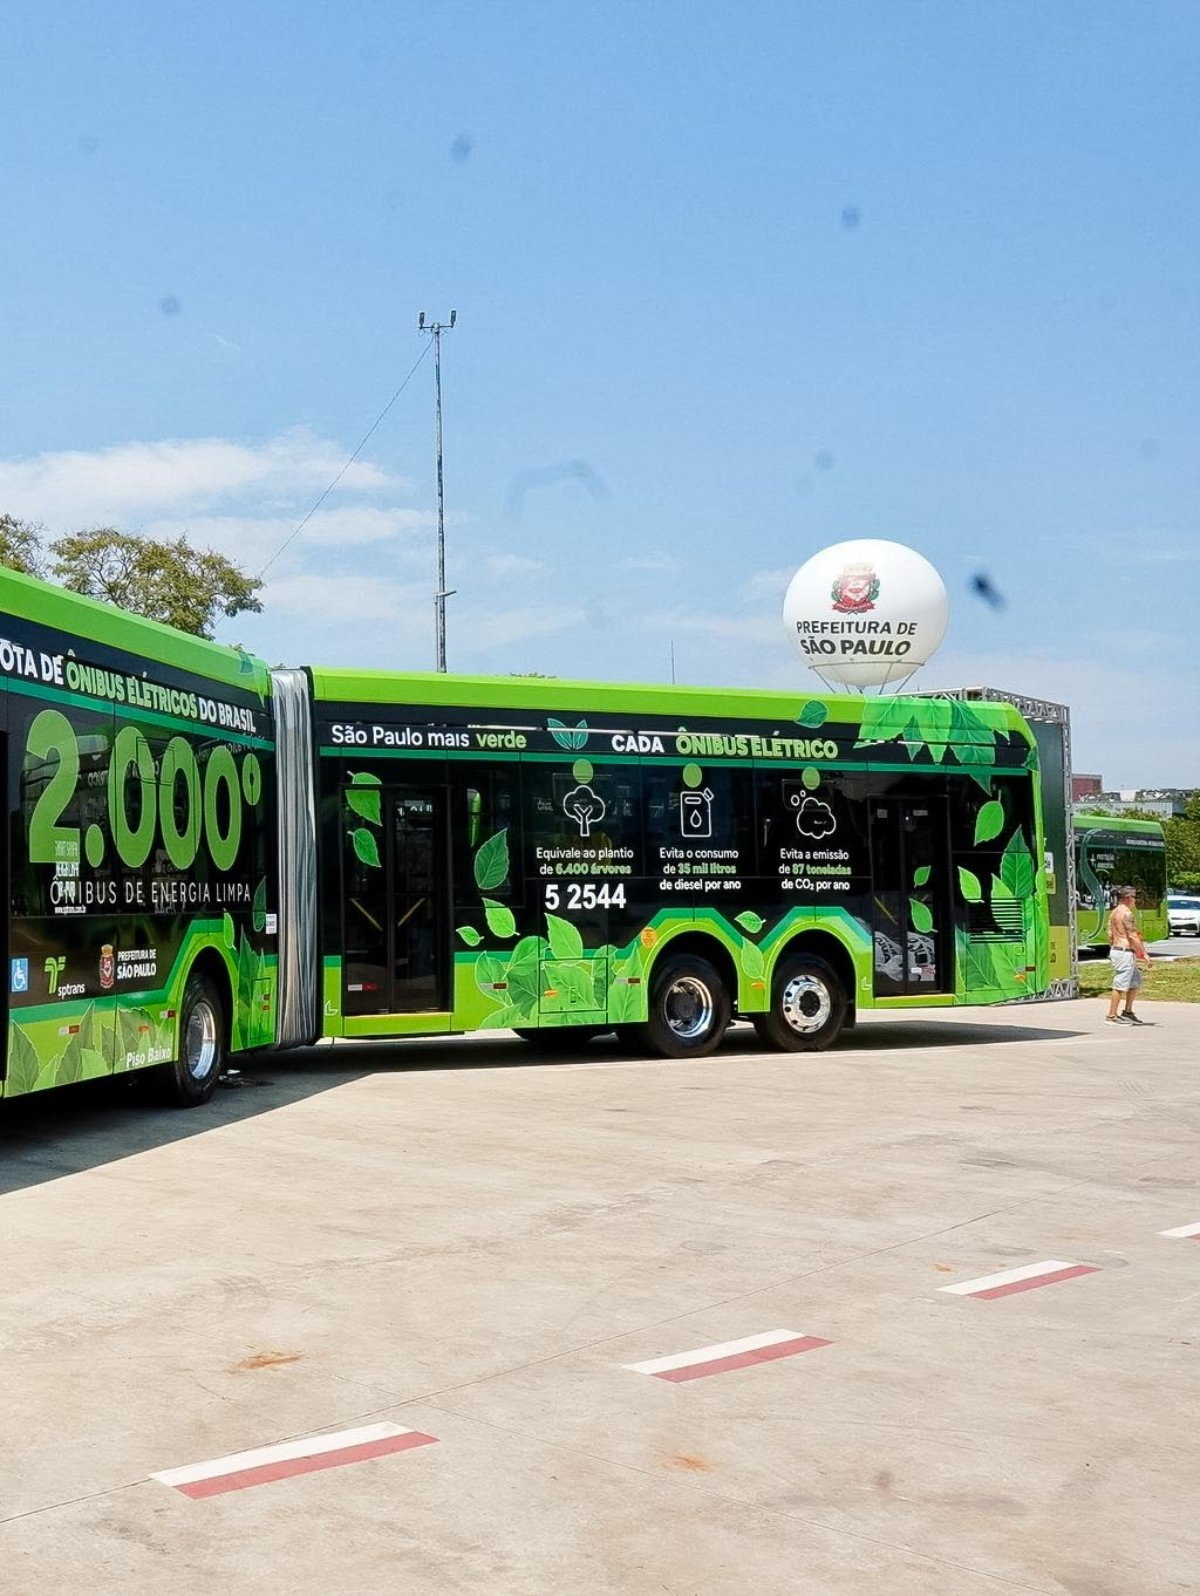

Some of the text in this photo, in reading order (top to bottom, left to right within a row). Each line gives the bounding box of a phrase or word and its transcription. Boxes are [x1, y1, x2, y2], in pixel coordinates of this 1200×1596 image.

[797, 620, 917, 635] PREFEITURA DE
[800, 636, 911, 655] SÃO PAULO
[40, 655, 63, 685] DE
[66, 649, 125, 702] ÔNIBUS
[127, 671, 198, 719] ELÉTRICOS
[199, 697, 217, 723] DO
[218, 703, 256, 733] BRASIL
[332, 724, 527, 748] São Paulo mais verde
[611, 726, 838, 759] CADA ÔNIBUS ELÉTRICO
[536, 847, 634, 861] Equivale ao plantio
[660, 847, 739, 859] Evita o consumo
[780, 848, 849, 860] Evita a emissão
[540, 864, 553, 875] de
[555, 863, 588, 875] 6.400
[663, 864, 676, 874] de
[693, 863, 708, 874] mil
[710, 863, 736, 875] litros
[779, 864, 791, 874] de
[50, 874, 117, 904] ÔNIBUS
[126, 881, 144, 903] DE
[152, 881, 211, 904] ENERGIA
[216, 882, 251, 902] LIMPA
[660, 879, 742, 892] de diesel por ano
[781, 879, 793, 890] de
[816, 880, 831, 892] por
[833, 880, 850, 890] ano
[545, 883, 627, 910] 5 2544
[117, 948, 157, 961] PREFEITURA DE
[117, 961, 156, 979] SÃO PAULO
[57, 983, 85, 999] sptrans
[126, 1046, 172, 1069] Piso Baixo
